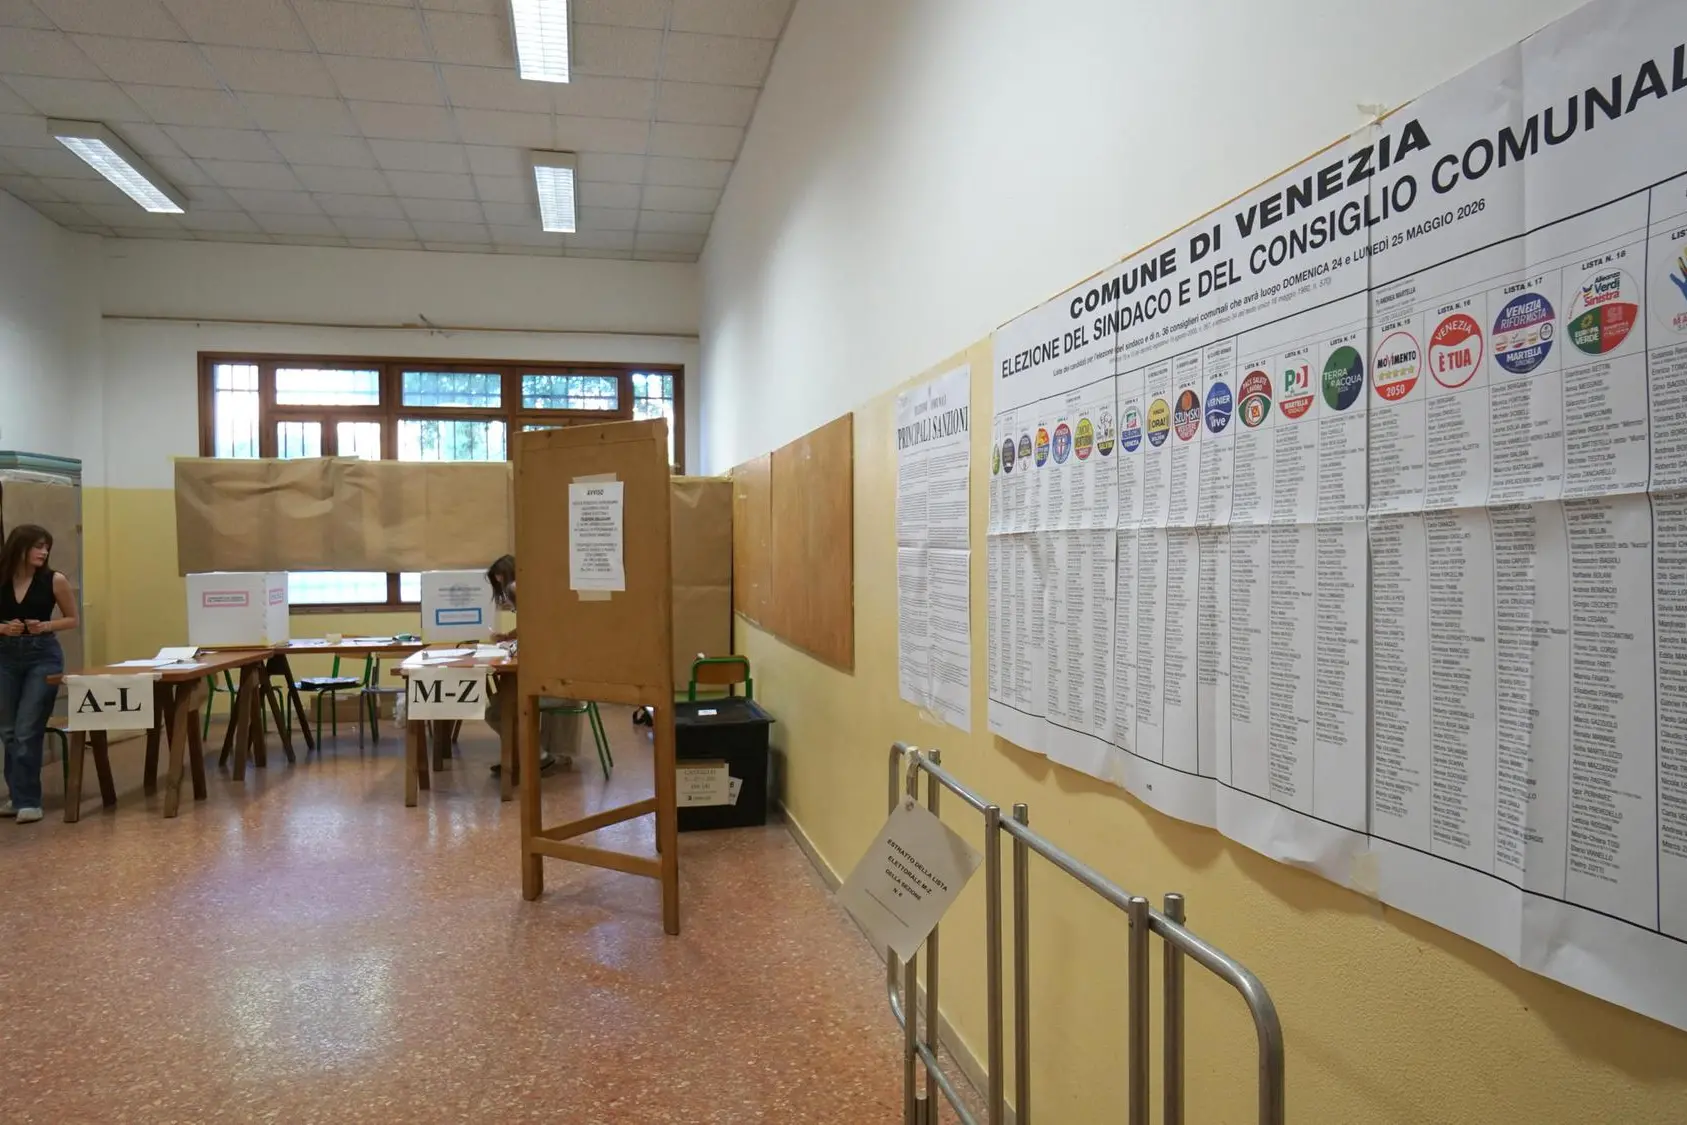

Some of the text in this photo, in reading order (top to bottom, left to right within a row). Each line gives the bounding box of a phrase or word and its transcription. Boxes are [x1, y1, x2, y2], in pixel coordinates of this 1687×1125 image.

[1002, 337, 1060, 379] ELEZIONE
[1064, 325, 1089, 354] DEL
[1093, 288, 1171, 341] SINDACO
[1179, 278, 1191, 306] E
[1198, 258, 1242, 299] DEL
[1250, 174, 1417, 275] CONSIGLIO
[1431, 43, 1687, 194] COMUNAL
[1070, 119, 1431, 319] COMUNE DI VENEZIA
[1671, 229, 1687, 241] LIS
[1582, 258, 1603, 271] LISTA
[1125, 336, 1144, 350] sindaco
[1162, 327, 1170, 336] 36
[1170, 314, 1200, 332] consiglieri
[1200, 304, 1229, 321] comunali
[1229, 298, 1242, 310] che
[1243, 292, 1259, 305] avrà
[1259, 283, 1281, 300] luogo
[1282, 263, 1329, 289] DOMENICA
[1331, 257, 1343, 271] 24
[1344, 256, 1351, 265] e
[1353, 235, 1389, 262] LUNEDÌ
[1391, 232, 1404, 247] 25
[1406, 211, 1453, 241] MAGGIO
[1456, 198, 1486, 221] 2026
[1504, 283, 1525, 294] LISTA
[1594, 278, 1621, 295] Verdi
[1437, 305, 1454, 315] LISTA
[1464, 299, 1471, 307] 16
[1584, 290, 1620, 307] Sinistra
[1506, 299, 1542, 318] VENEZIA
[1381, 323, 1396, 332] LISTA
[1501, 308, 1547, 329] RIFORMISTA
[1435, 319, 1472, 341] VENEZIA
[1575, 334, 1600, 345] VERDE
[1377, 350, 1417, 369] MOVIMENTO
[1439, 348, 1472, 372] È TUA
[1506, 346, 1542, 363] MARTELLA
[1284, 364, 1309, 392] PD
[1324, 368, 1348, 381] TERRA
[1386, 384, 1406, 397] 2050
[1207, 395, 1230, 408] VERNIER
[1151, 417, 1166, 428] ORA!
[1174, 408, 1200, 424] SZUMSKI
[1210, 414, 1226, 427] live
[897, 406, 968, 450] PRINCIPALI SANZIONI
[77, 688, 142, 713] A-L
[412, 680, 480, 703] M-Z
[887, 839, 948, 892] ESTRATTO DELLA LISTA
[888, 855, 922, 885] ELETTORALE
[885, 869, 922, 900] DELLA SEZIONE
